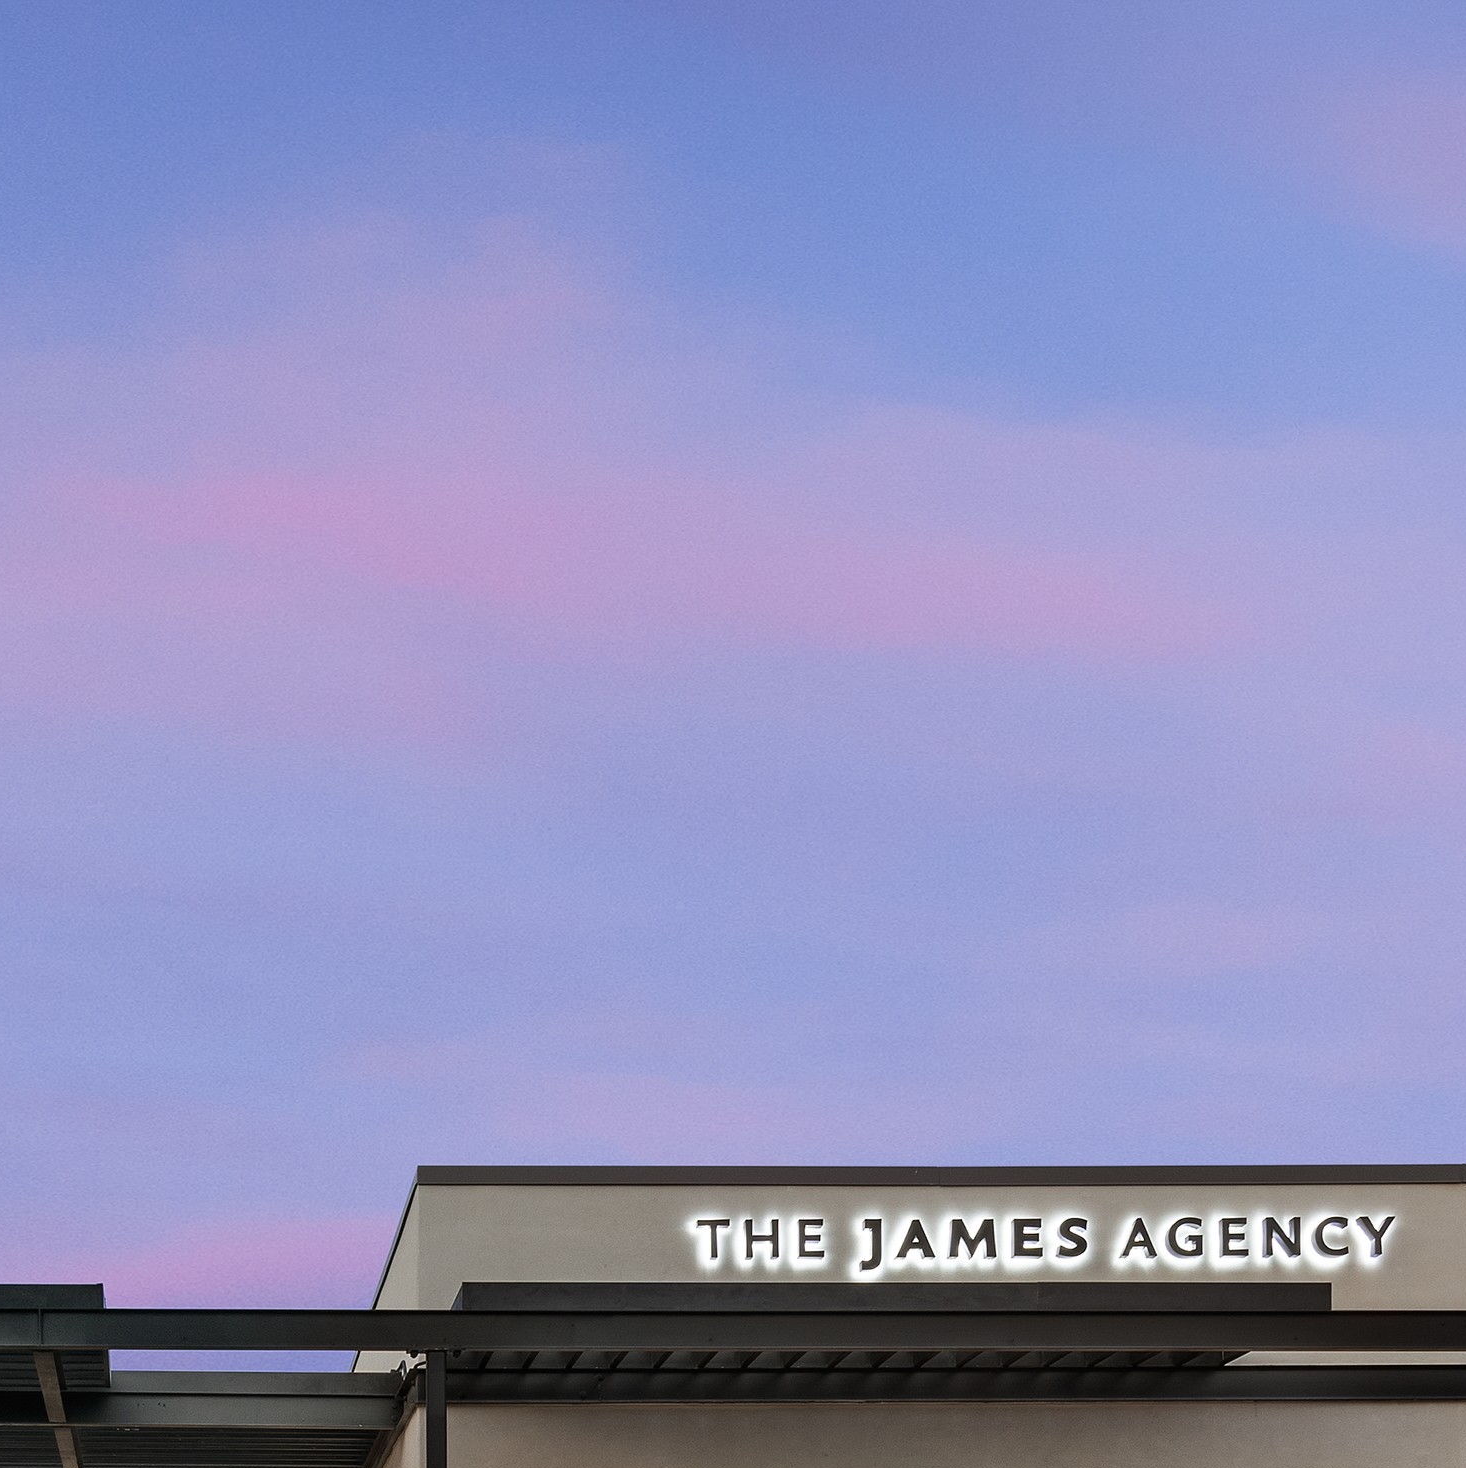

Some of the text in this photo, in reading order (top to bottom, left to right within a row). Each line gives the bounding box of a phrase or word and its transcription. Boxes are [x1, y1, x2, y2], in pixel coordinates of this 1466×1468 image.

[696, 1216, 1396, 1271] THE JAMES AGENCY
